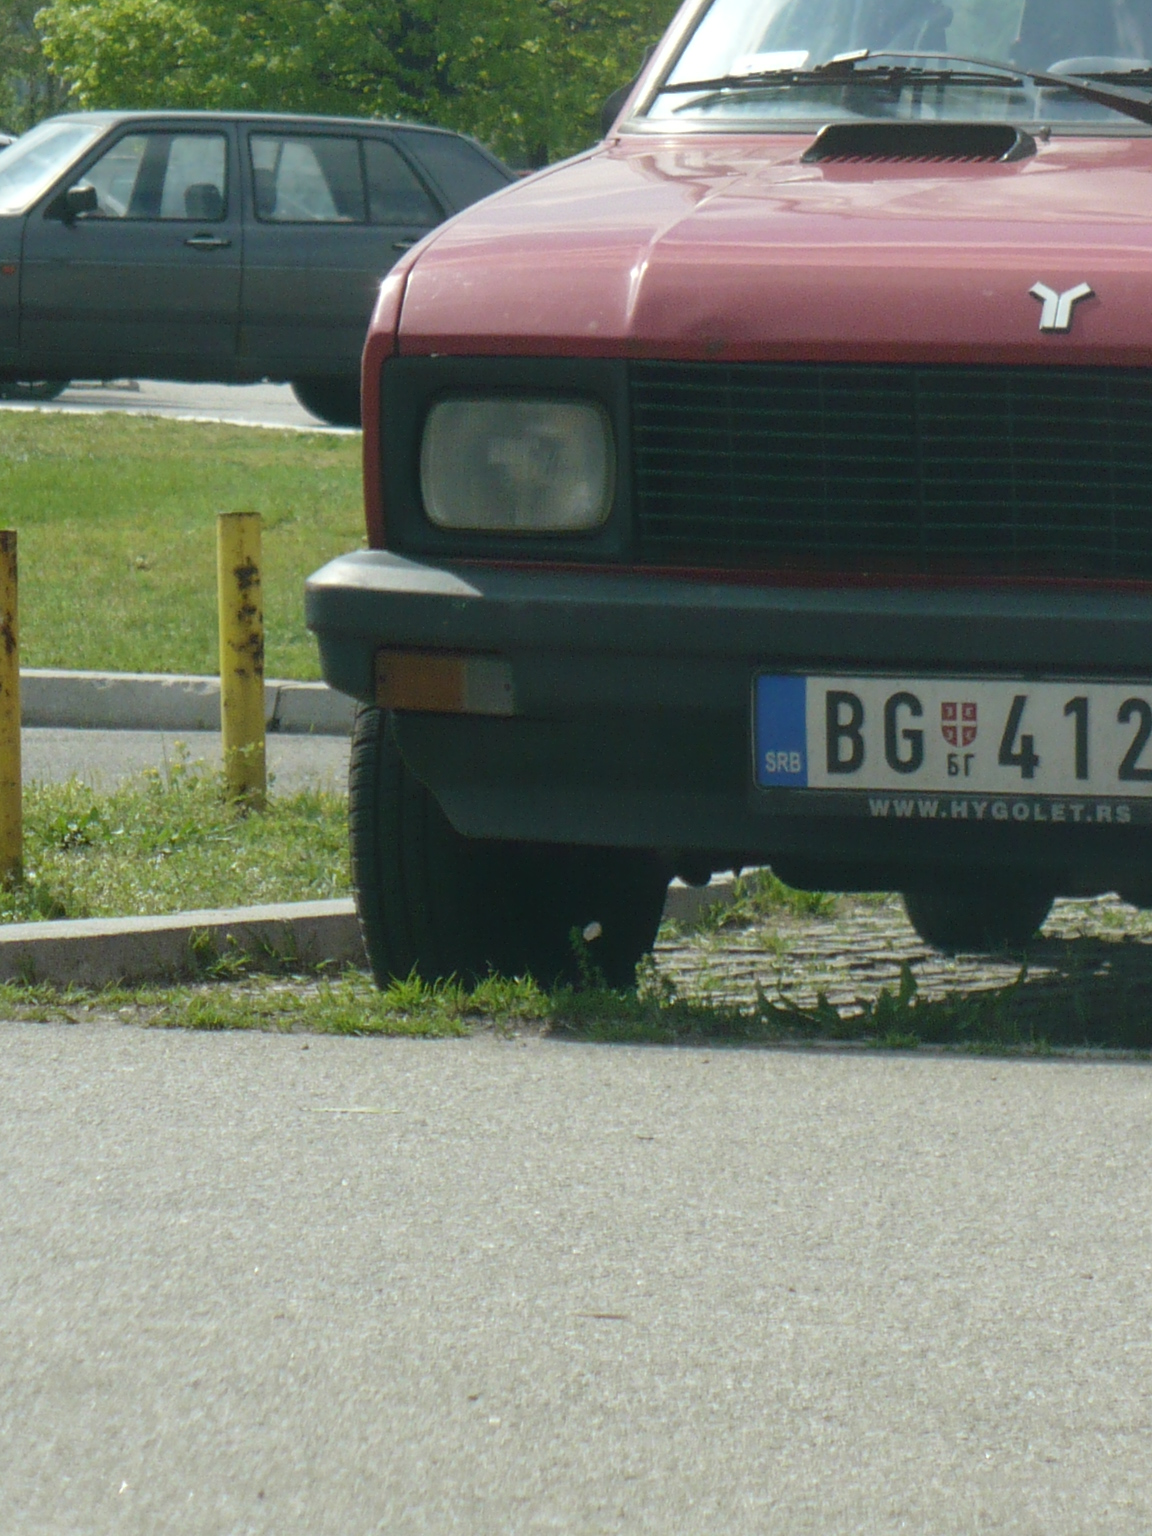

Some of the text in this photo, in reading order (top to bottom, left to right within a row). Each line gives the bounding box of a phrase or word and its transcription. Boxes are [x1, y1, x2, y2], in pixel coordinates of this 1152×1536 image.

[826, 690, 924, 774] BG
[765, 751, 802, 773] SRB
[946, 753, 975, 776] БГ
[868, 797, 1132, 824] WWW.HYGOLET.RS
